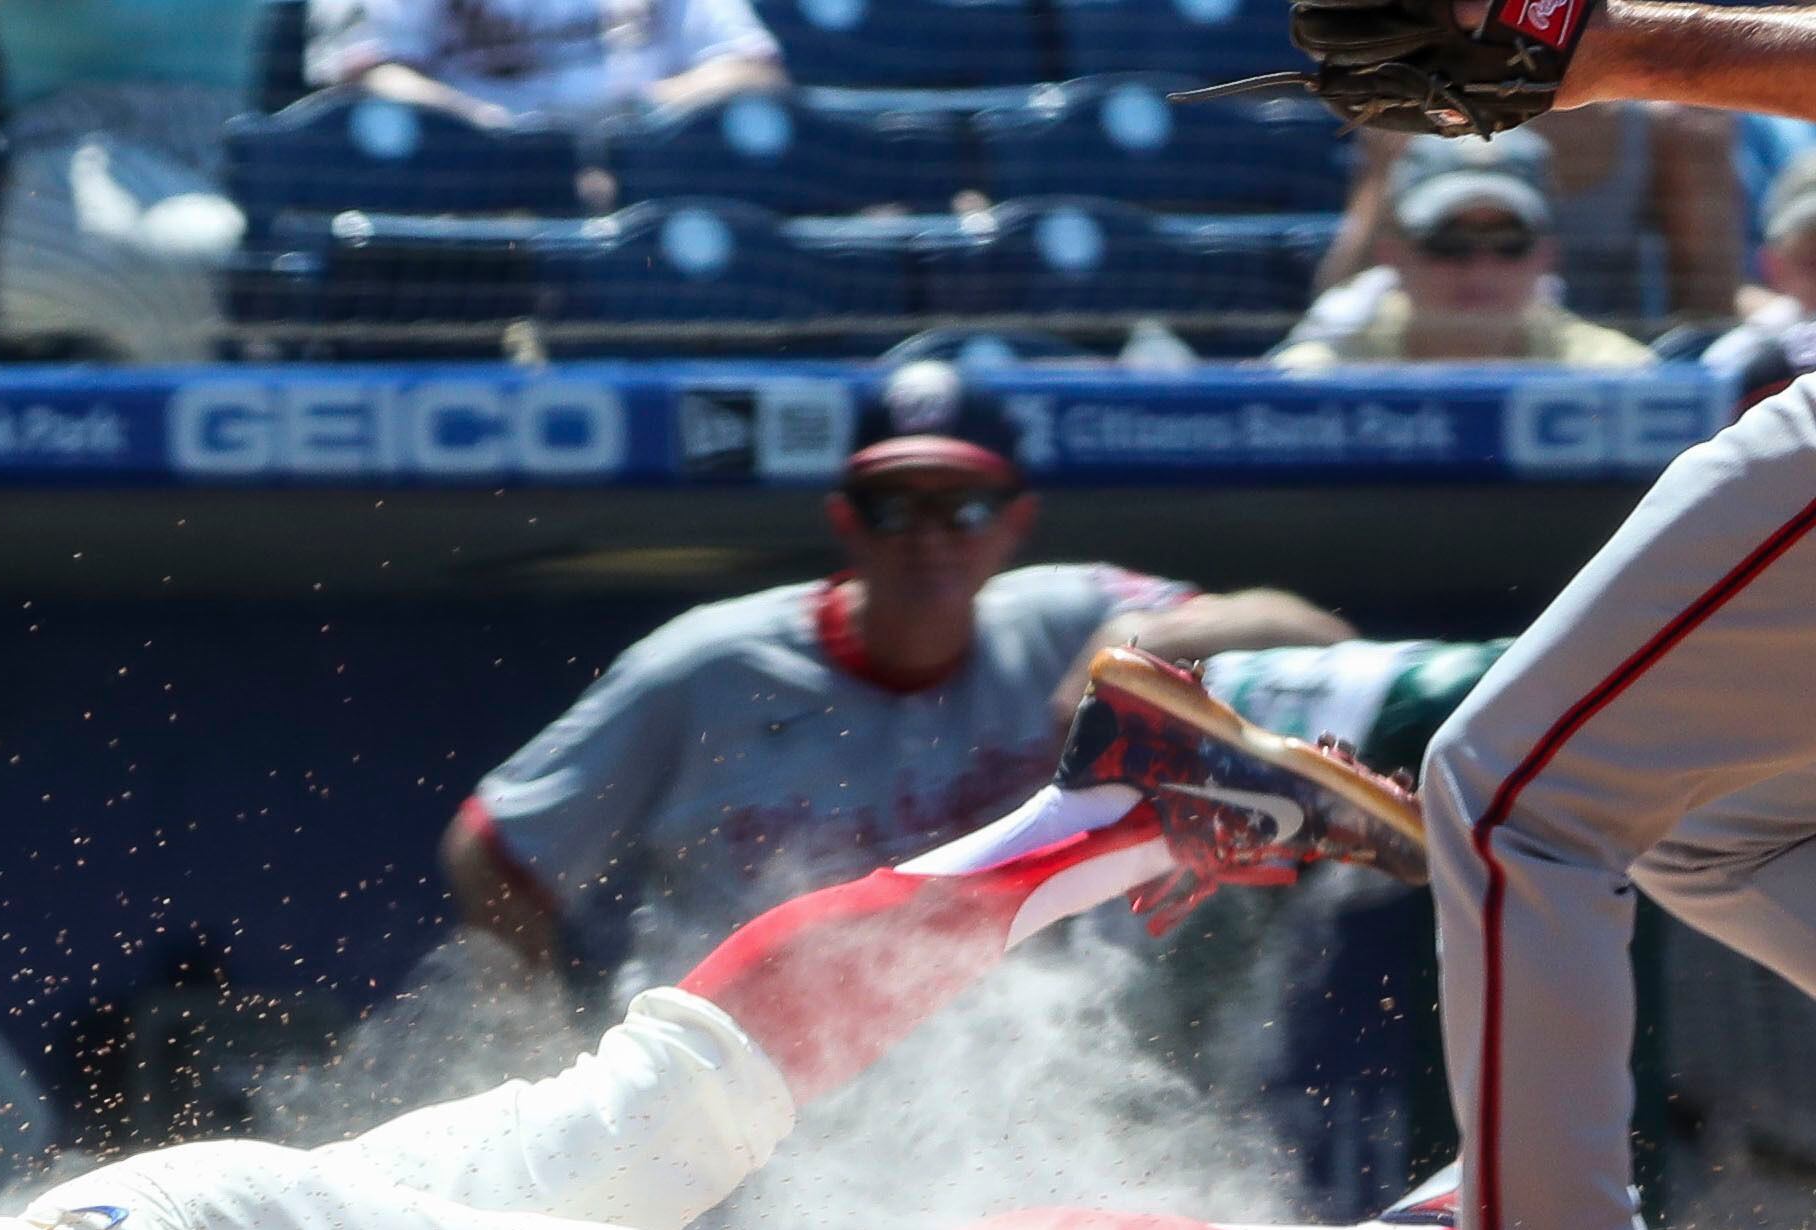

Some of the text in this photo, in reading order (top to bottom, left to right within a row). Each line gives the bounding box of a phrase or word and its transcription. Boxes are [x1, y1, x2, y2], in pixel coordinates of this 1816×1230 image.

[23, 402, 125, 453] Park
[167, 378, 626, 473] GEICO
[1241, 402, 1346, 451] Bank
[1355, 402, 1454, 451] Park
